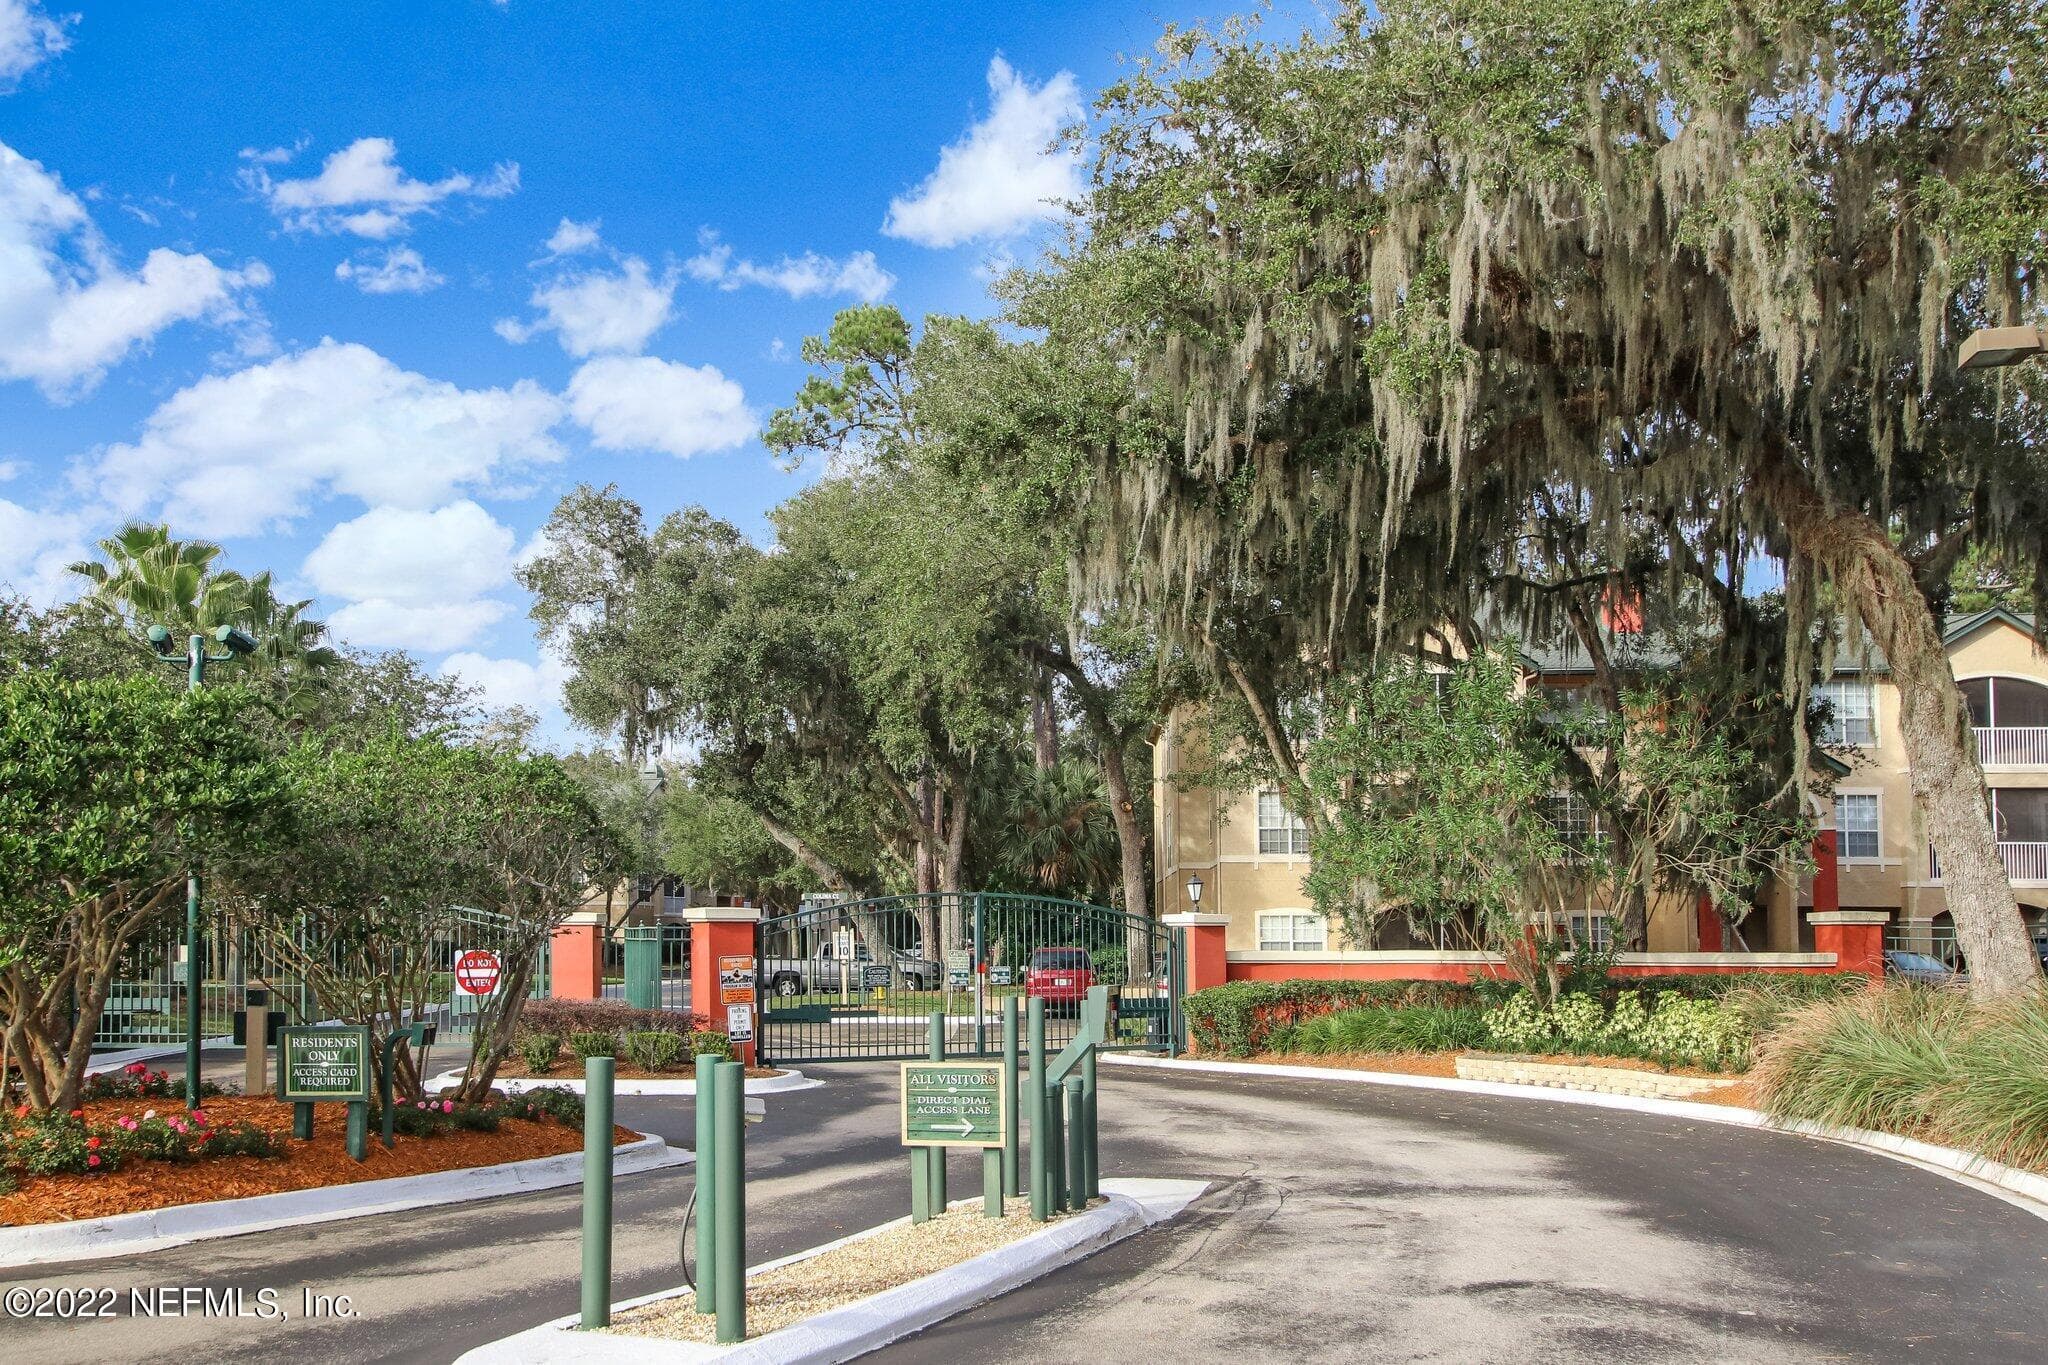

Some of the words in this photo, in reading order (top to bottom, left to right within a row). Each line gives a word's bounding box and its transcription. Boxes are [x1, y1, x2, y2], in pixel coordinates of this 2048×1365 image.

[463, 959, 474, 967] DO
[477, 959, 493, 967] NOT
[466, 979, 491, 987] ENTER
[292, 1037, 358, 1048] RESIDENTS
[308, 1050, 341, 1061] ONLY
[293, 1068, 328, 1077] ACCESS
[329, 1068, 358, 1077] CARD
[300, 1077, 350, 1086] REQUIRED
[910, 1074, 935, 1085] ALL
[937, 1074, 997, 1085] VISITORS
[917, 1096, 960, 1105] DIRECT
[962, 1096, 990, 1105] DIAL
[916, 1106, 958, 1115] ACCESS
[961, 1106, 991, 1115] LANE
